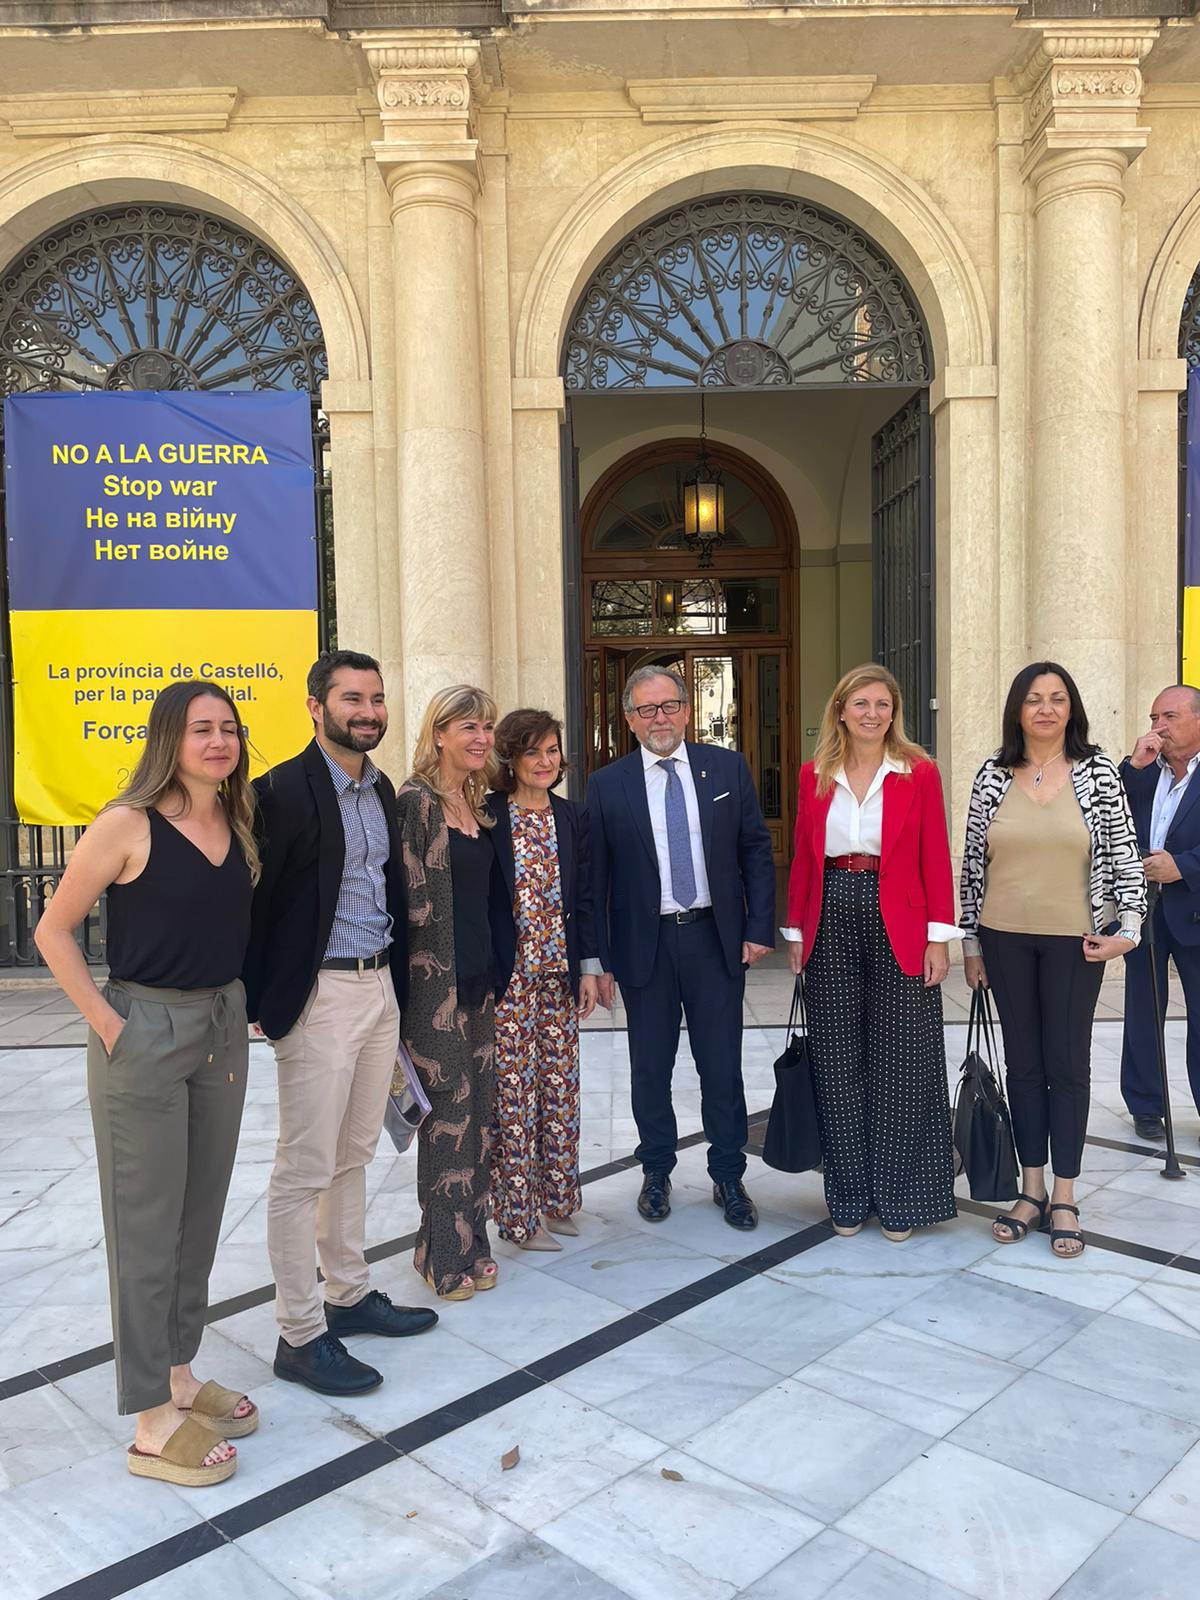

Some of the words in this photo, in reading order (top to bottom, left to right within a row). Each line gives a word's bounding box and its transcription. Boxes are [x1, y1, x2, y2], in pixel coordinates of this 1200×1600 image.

[52, 444, 89, 465] NO
[95, 443, 113, 464] A
[119, 443, 153, 464] LA
[158, 443, 269, 465] GUERRA
[103, 474, 163, 501] Stop
[169, 479, 217, 497] war
[86, 507, 119, 529] Не
[127, 511, 157, 529] на
[165, 506, 237, 534] війну
[95, 539, 141, 561] Нет
[149, 538, 229, 561] войне
[48, 663, 70, 680] La
[76, 661, 164, 683] província
[170, 662, 195, 679] de
[199, 662, 284, 682] Castelló,
[74, 688, 104, 705] per
[110, 686, 126, 701] la
[132, 688, 161, 705] pa
[84, 720, 149, 745] Força
